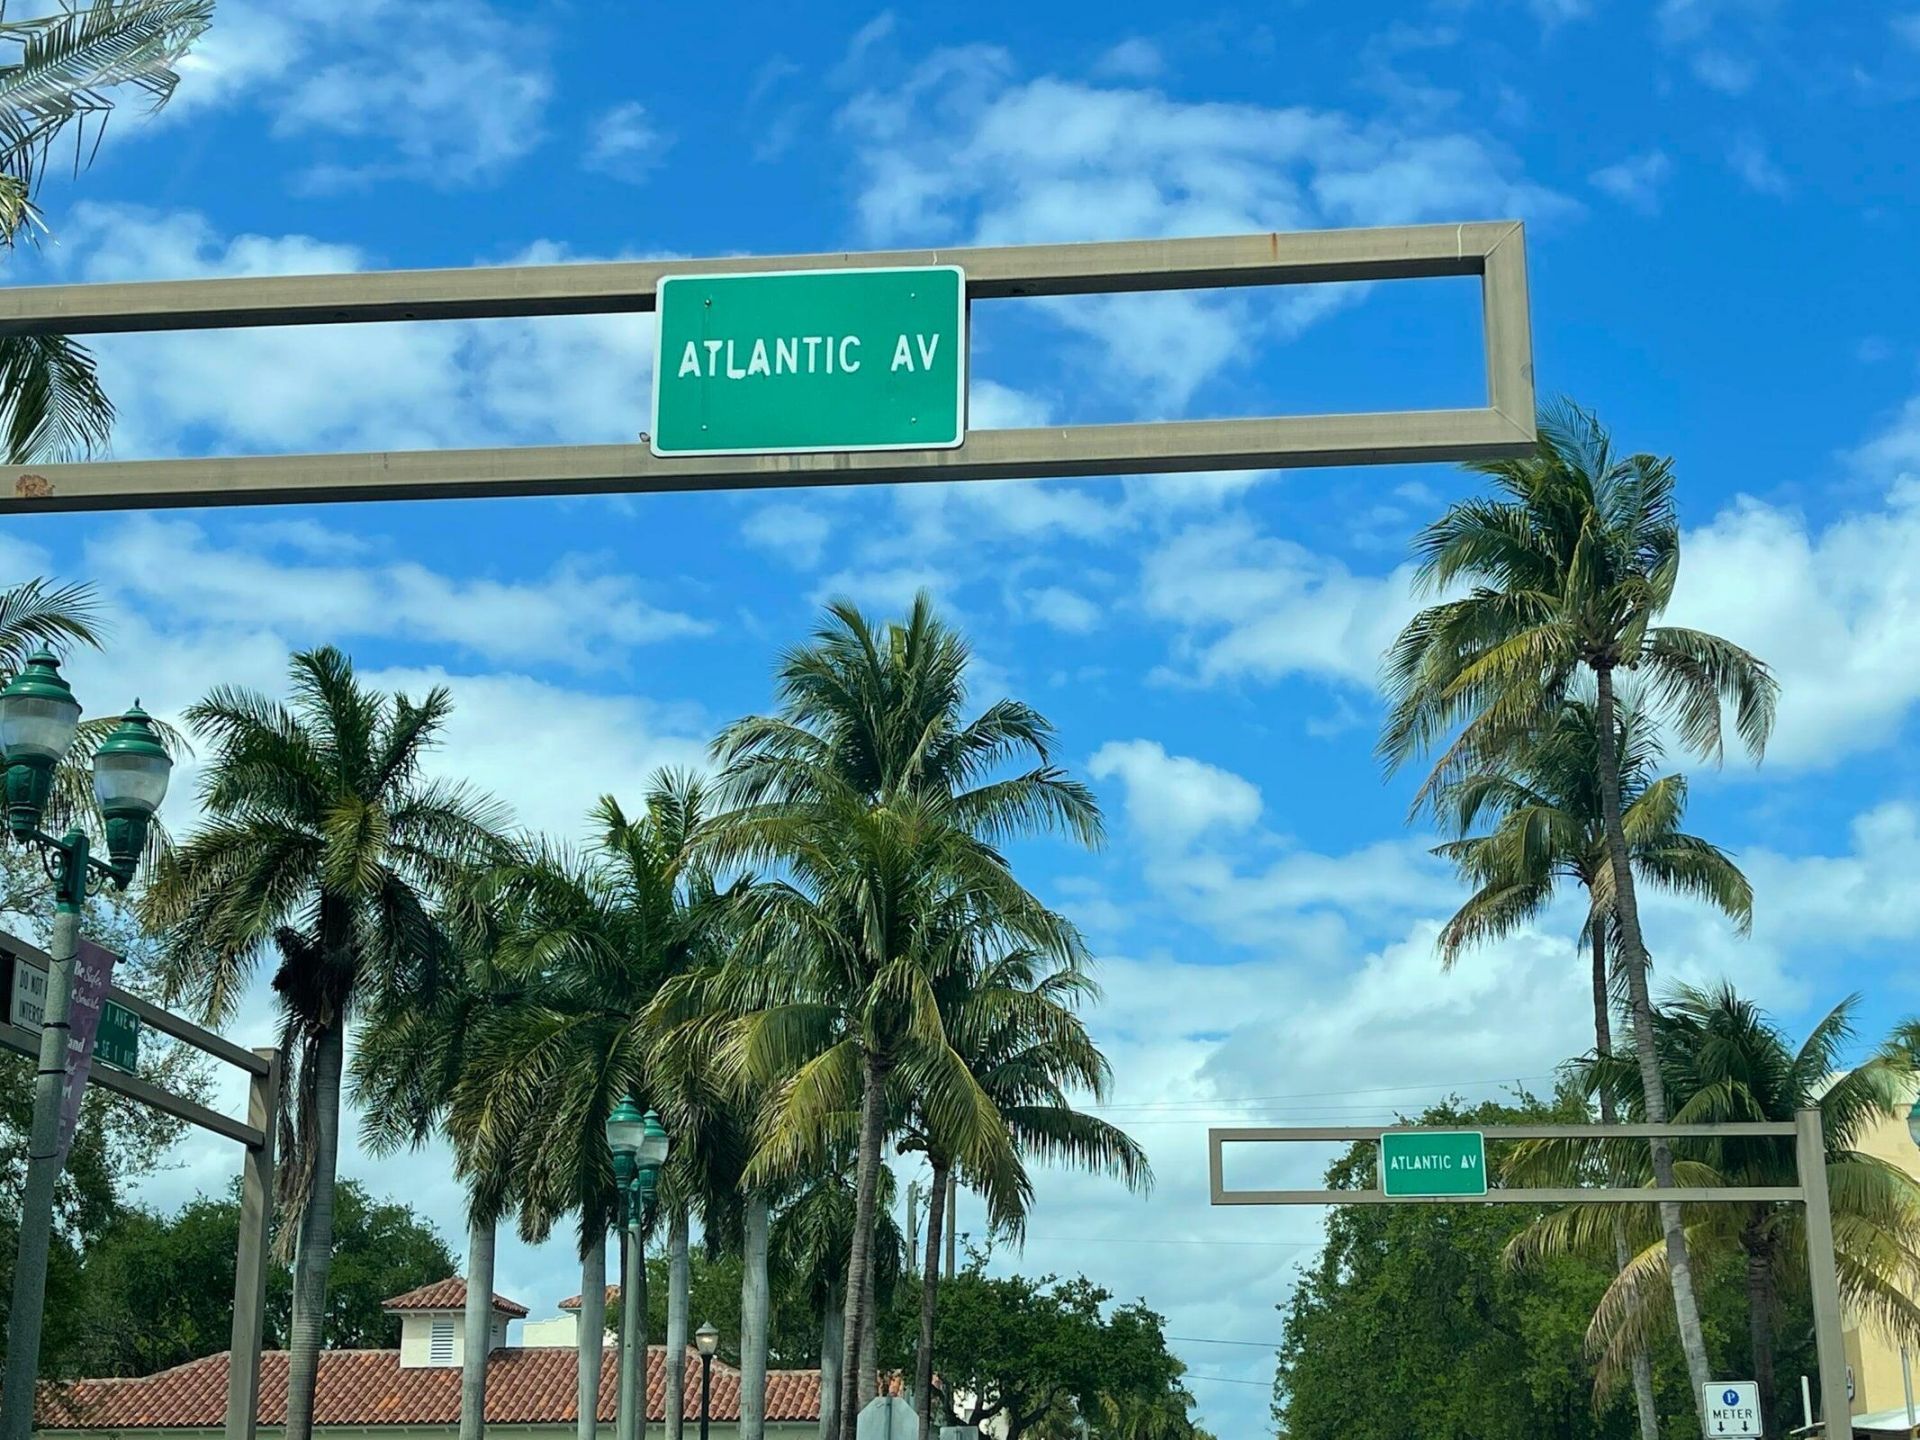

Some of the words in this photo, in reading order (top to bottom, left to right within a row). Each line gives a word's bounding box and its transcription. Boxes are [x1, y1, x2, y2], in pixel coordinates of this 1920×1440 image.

[678, 335, 861, 380] ATLANTIC
[891, 333, 939, 372] AV
[74, 960, 86, 978] Be
[20, 969, 29, 990] DO
[31, 975, 43, 996] NOT
[114, 1008, 128, 1030] AVE
[101, 1039, 111, 1059] SE
[1391, 1154, 1452, 1170] ATLANTIC
[1460, 1154, 1477, 1169] AV
[1712, 1408, 1753, 1420] METER
